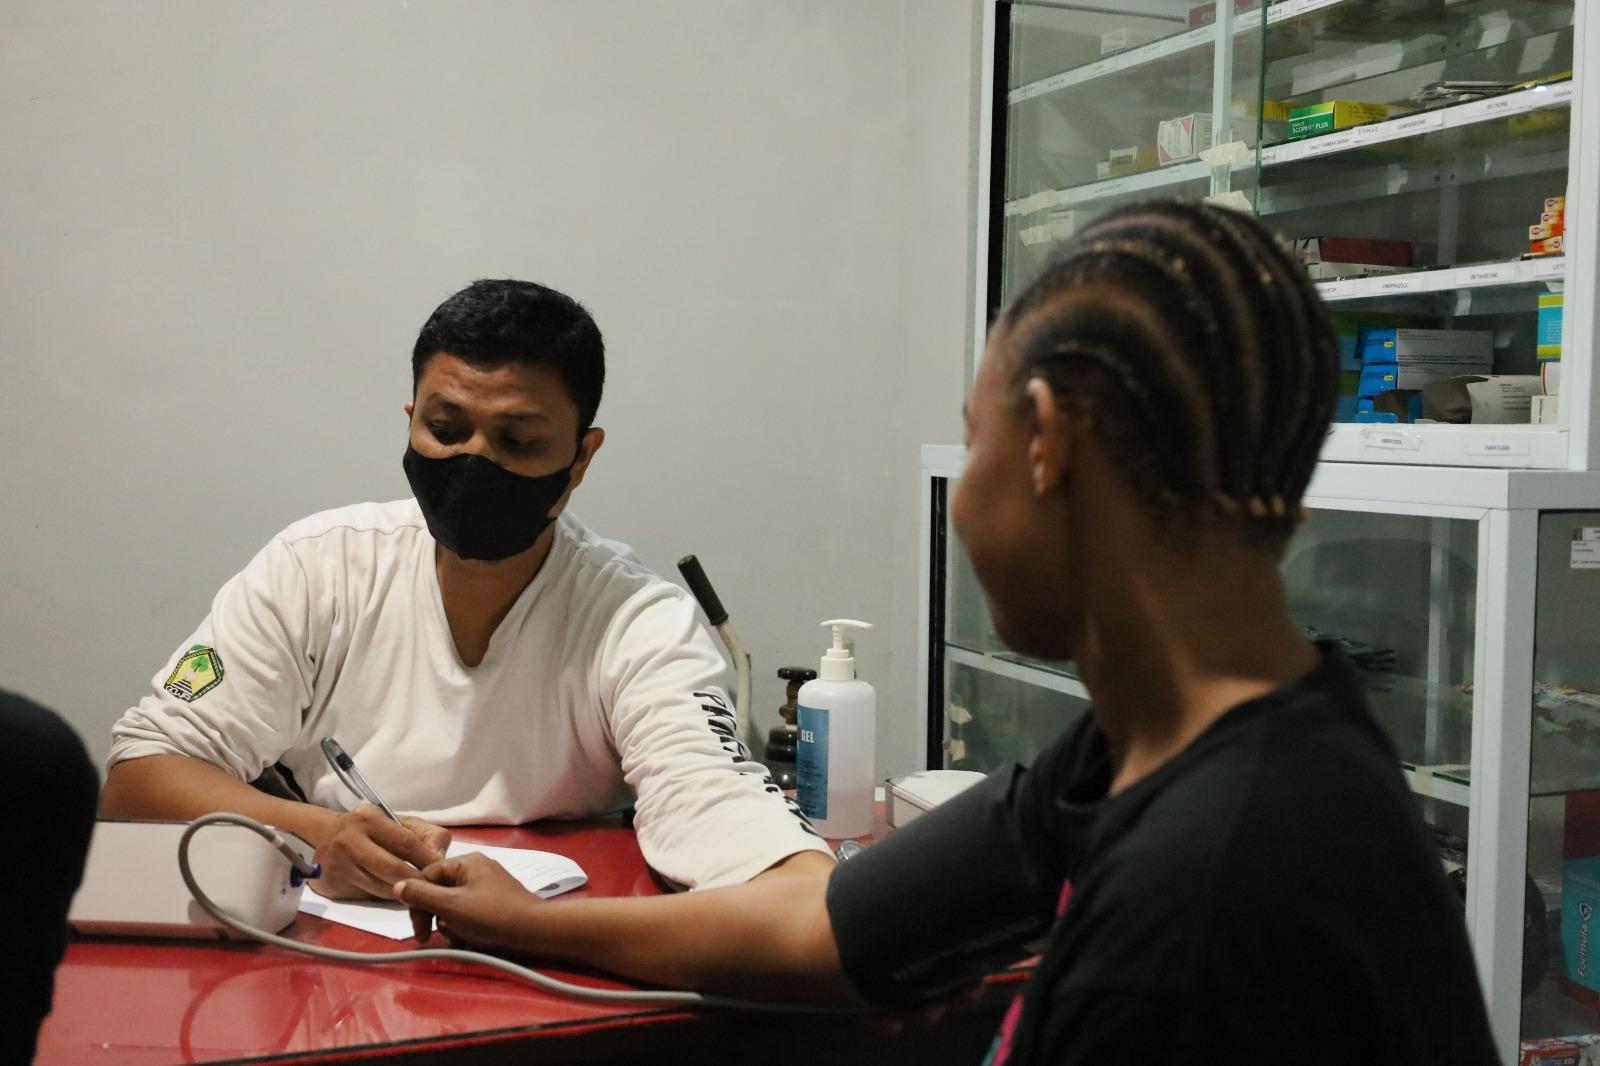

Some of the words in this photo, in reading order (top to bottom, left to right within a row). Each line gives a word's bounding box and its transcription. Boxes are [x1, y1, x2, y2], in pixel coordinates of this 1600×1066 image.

[1315, 121, 1329, 129] PLUS
[801, 729, 814, 743] GEL
[1577, 923, 1590, 977] Formula
